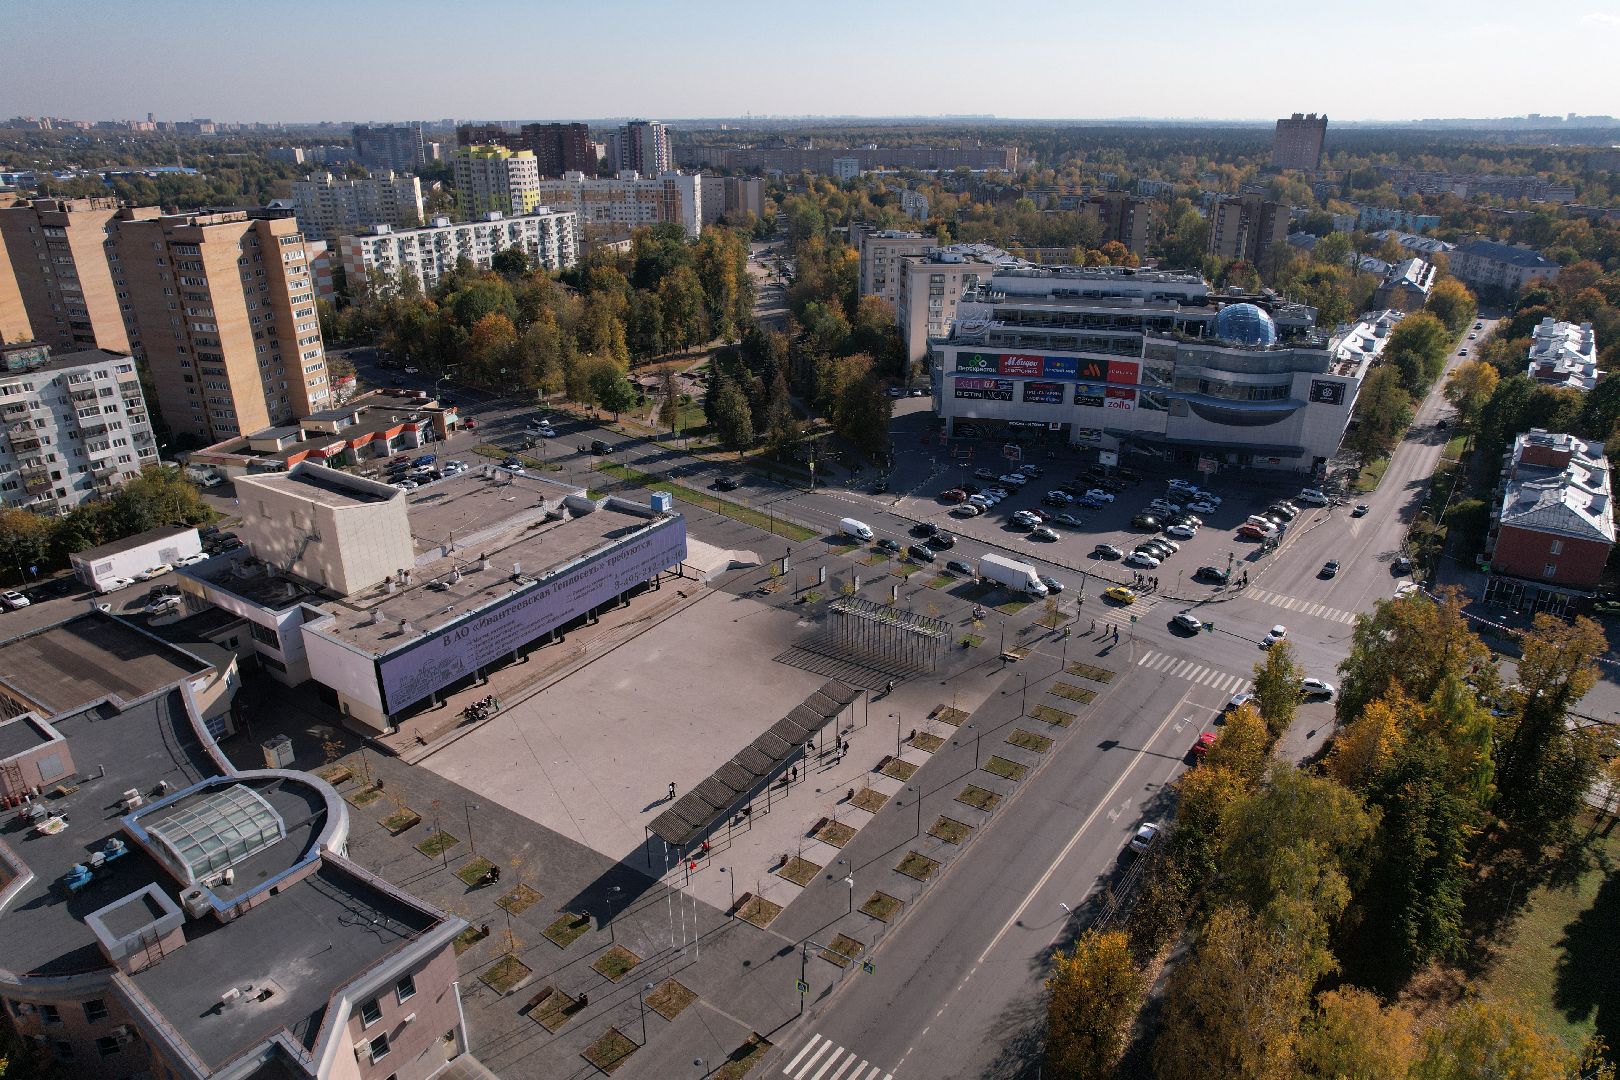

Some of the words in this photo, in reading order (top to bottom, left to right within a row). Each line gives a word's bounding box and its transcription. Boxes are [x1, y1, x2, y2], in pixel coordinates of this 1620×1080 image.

[1108, 401, 1131, 410] zolla
[442, 633, 451, 646] В
[453, 625, 469, 641] АО
